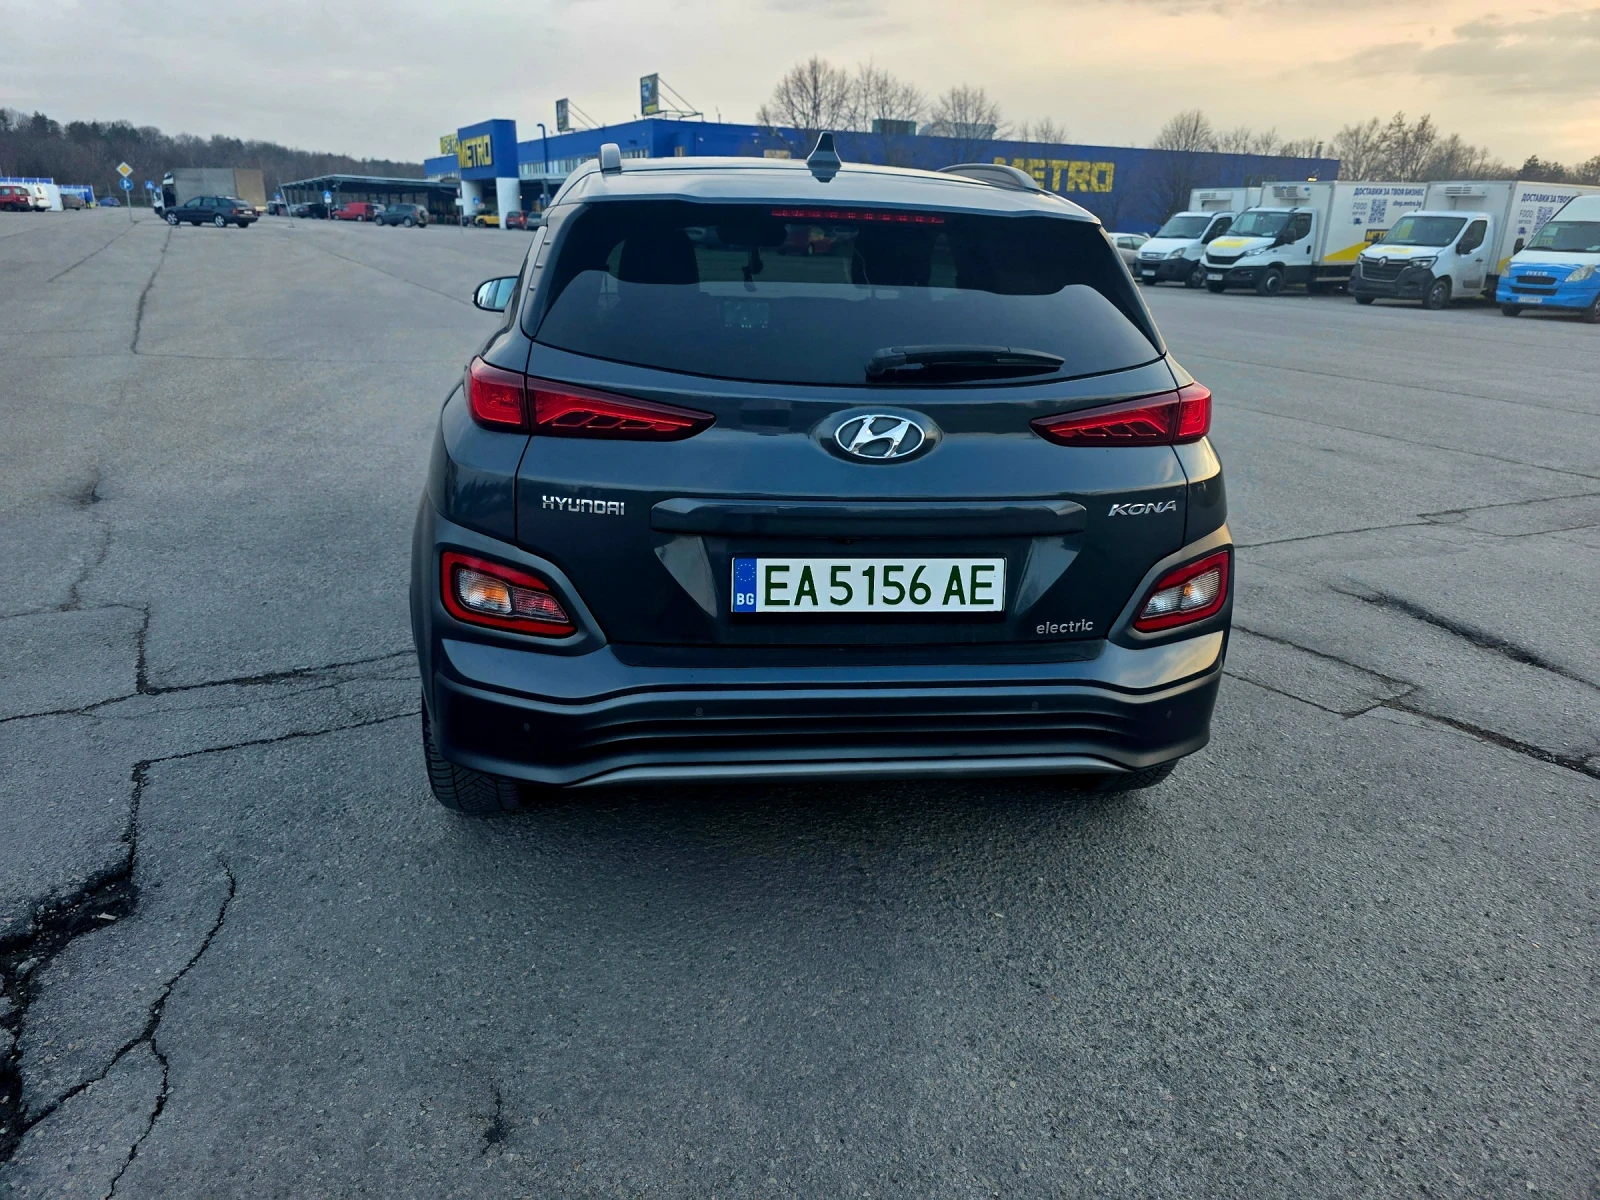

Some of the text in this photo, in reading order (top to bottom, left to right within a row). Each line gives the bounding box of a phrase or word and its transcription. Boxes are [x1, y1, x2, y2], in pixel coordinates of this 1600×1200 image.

[458, 134, 492, 168] METRO
[1353, 187, 1425, 197] ДОСТАВКИ ЗА ТВОЯ БИЗНЕС
[1520, 193, 1550, 203] ДОСТАВКИ
[1549, 194, 1556, 203] ЗА
[1353, 202, 1368, 210] FOOD
[1519, 209, 1534, 218] FOOD
[542, 495, 625, 516] HYUNDAI
[1107, 500, 1177, 517] KONA
[764, 565, 995, 606] EA 5156 AE
[736, 593, 755, 606] BG
[1036, 618, 1094, 634] electric
